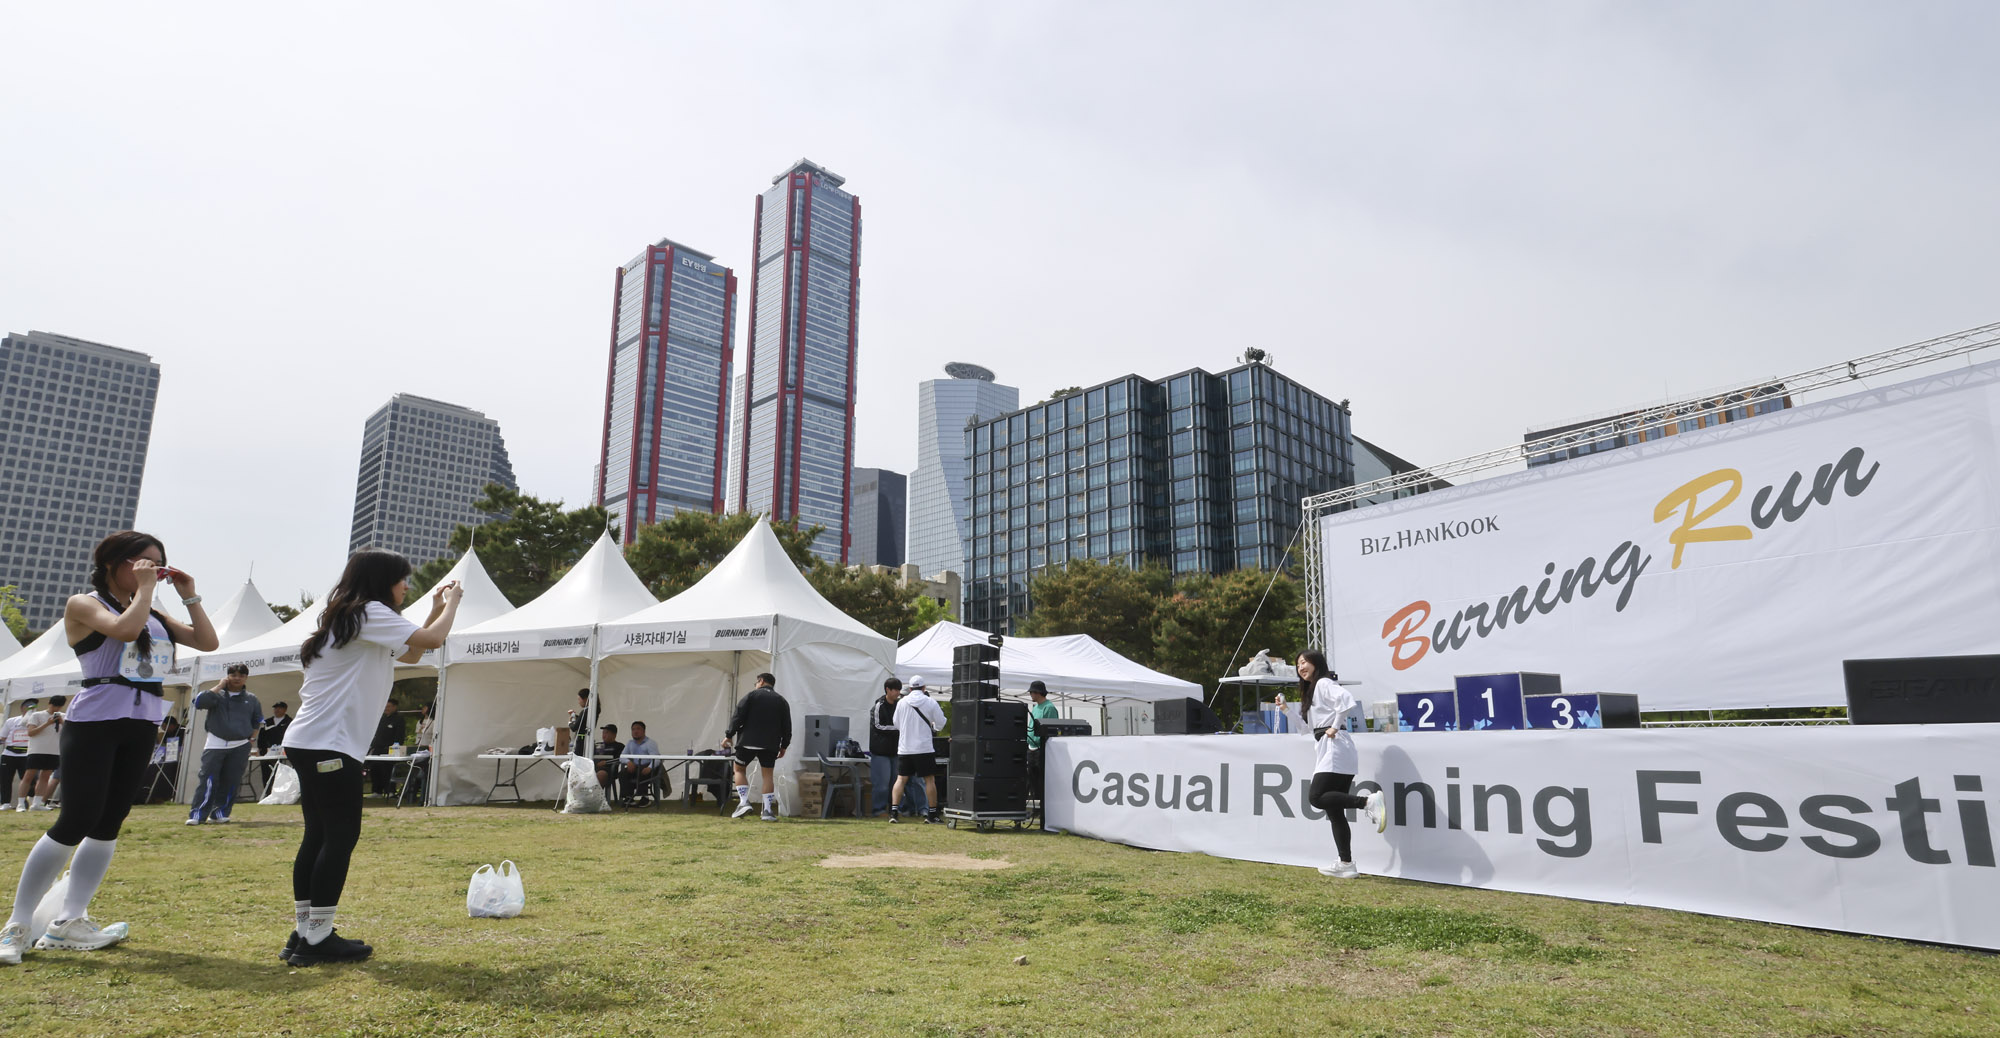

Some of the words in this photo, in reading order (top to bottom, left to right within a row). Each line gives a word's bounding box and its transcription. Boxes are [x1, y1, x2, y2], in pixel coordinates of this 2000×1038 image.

[1381, 540, 1652, 671] Burning
[1653, 446, 1881, 570] Run
[543, 638, 573, 647] BURNING
[574, 636, 589, 646] RUN
[624, 630, 687, 646] 사회자대기실
[715, 628, 750, 638] BURNING
[750, 627, 768, 637] RUN
[466, 640, 520, 655] 사회자대기실
[245, 658, 265, 668] ROOM
[1417, 698, 1436, 728] 2
[1480, 687, 1495, 718] 1
[1550, 698, 1574, 730] 3
[1072, 759, 1230, 814] Casual
[1636, 769, 1997, 868] Festi
